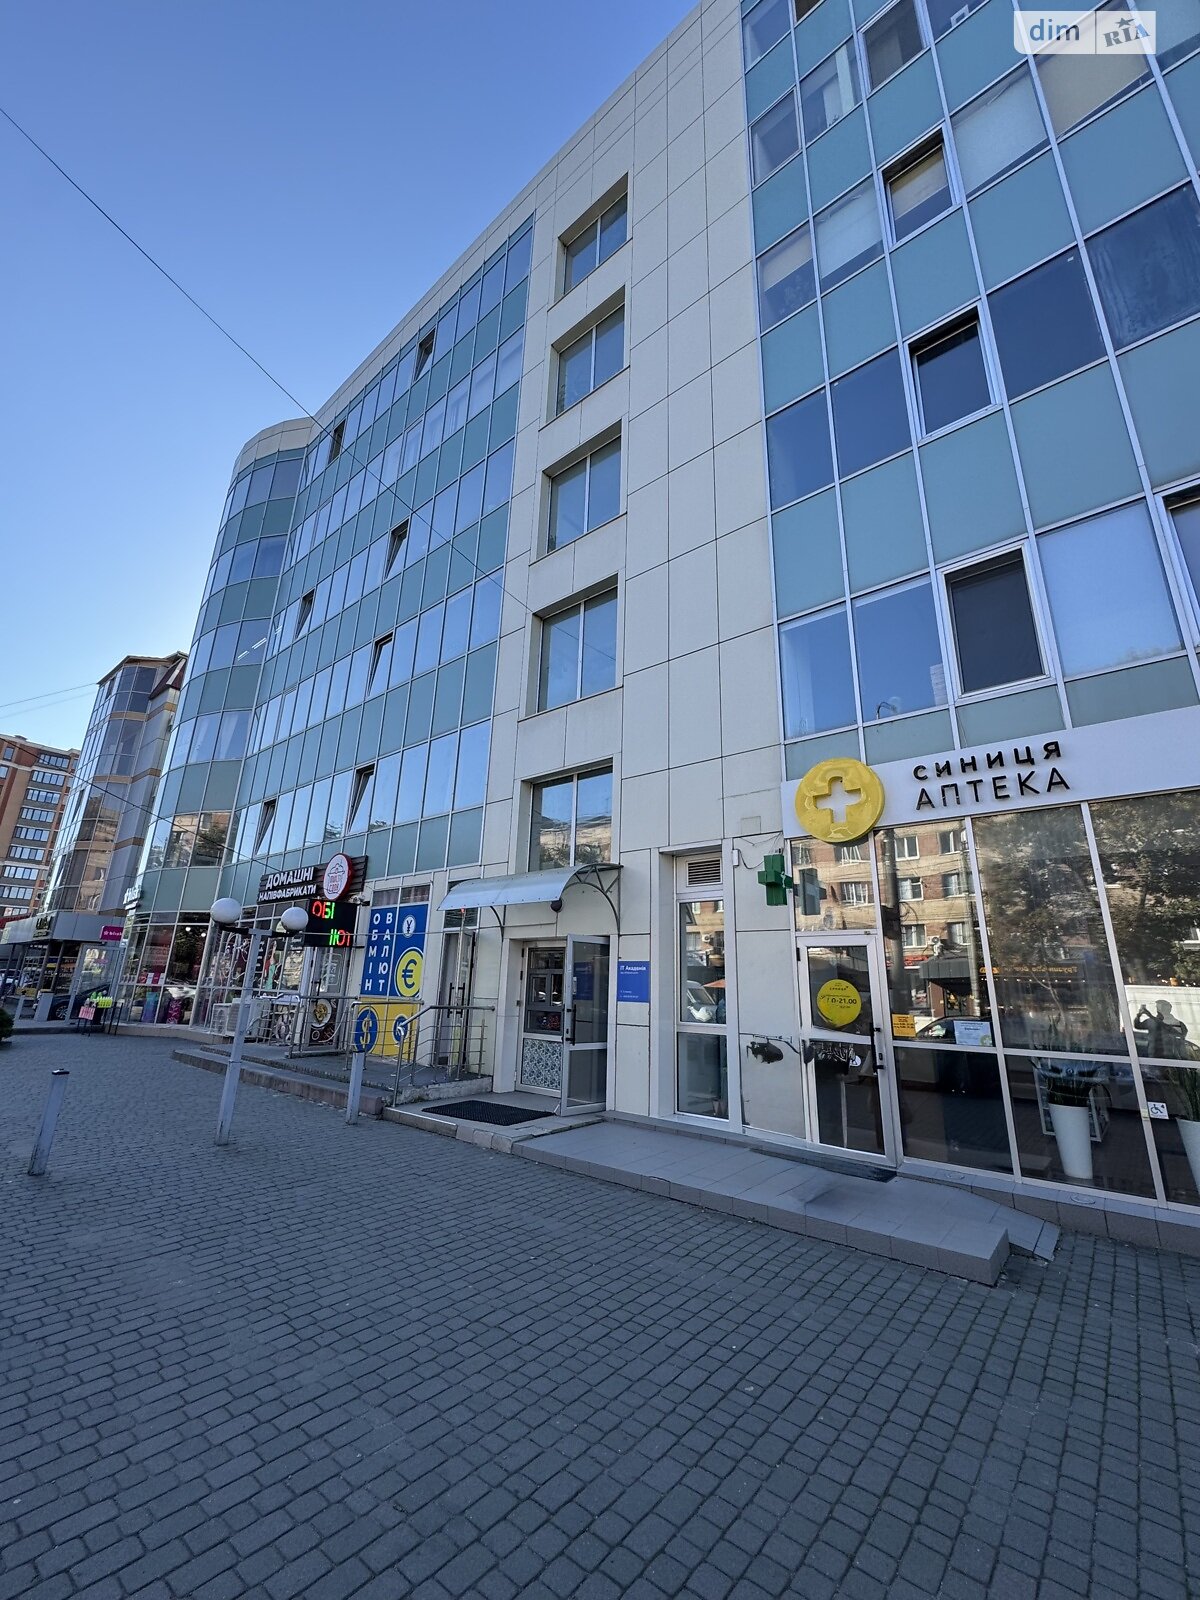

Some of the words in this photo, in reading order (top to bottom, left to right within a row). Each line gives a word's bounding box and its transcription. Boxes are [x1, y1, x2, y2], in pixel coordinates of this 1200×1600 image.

[912, 740, 1063, 781] СИНИЦЯ
[915, 767, 1071, 811] АПТЕКА
[258, 884, 317, 901] НАПІВФАБРИКАТИ
[265, 866, 315, 890] ДОМАШНІ
